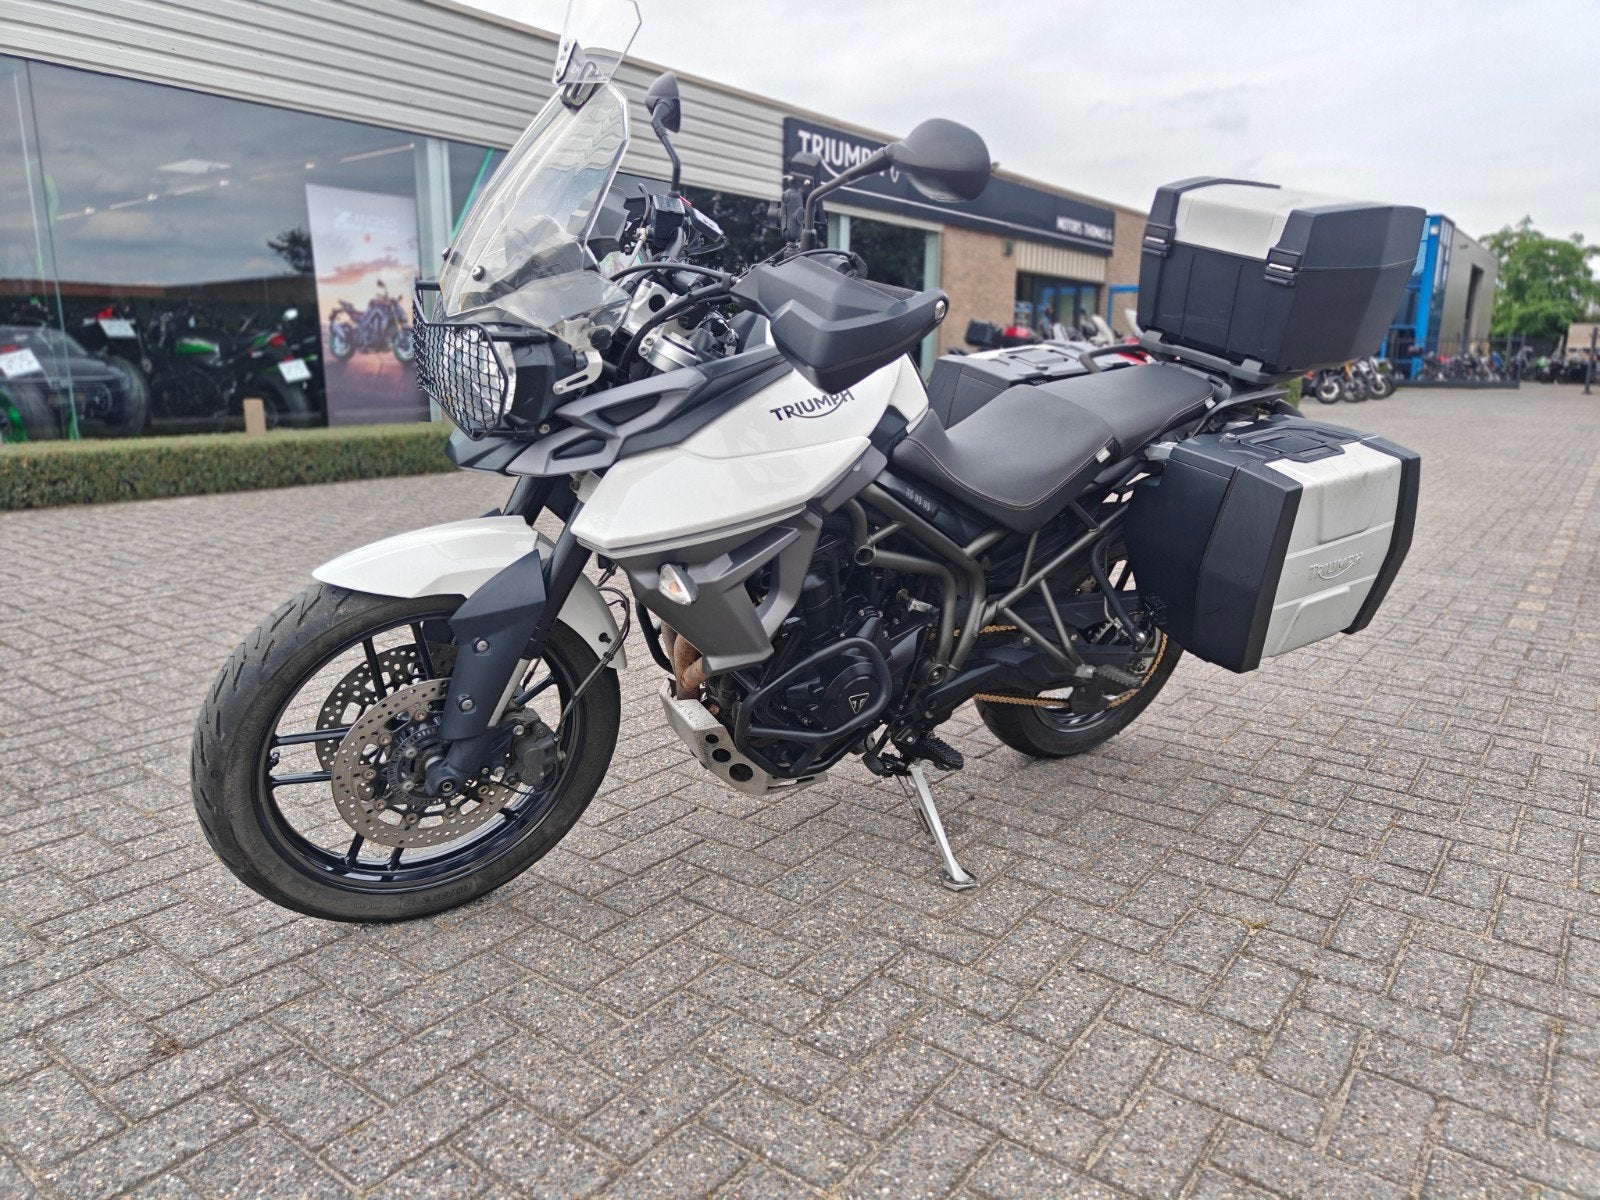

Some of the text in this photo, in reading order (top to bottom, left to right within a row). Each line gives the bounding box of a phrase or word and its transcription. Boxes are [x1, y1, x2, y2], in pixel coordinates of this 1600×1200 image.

[797, 130, 886, 177] TRIUMP
[770, 389, 855, 421] TRIUMPH
[1308, 551, 1363, 580] TRIUMPH
